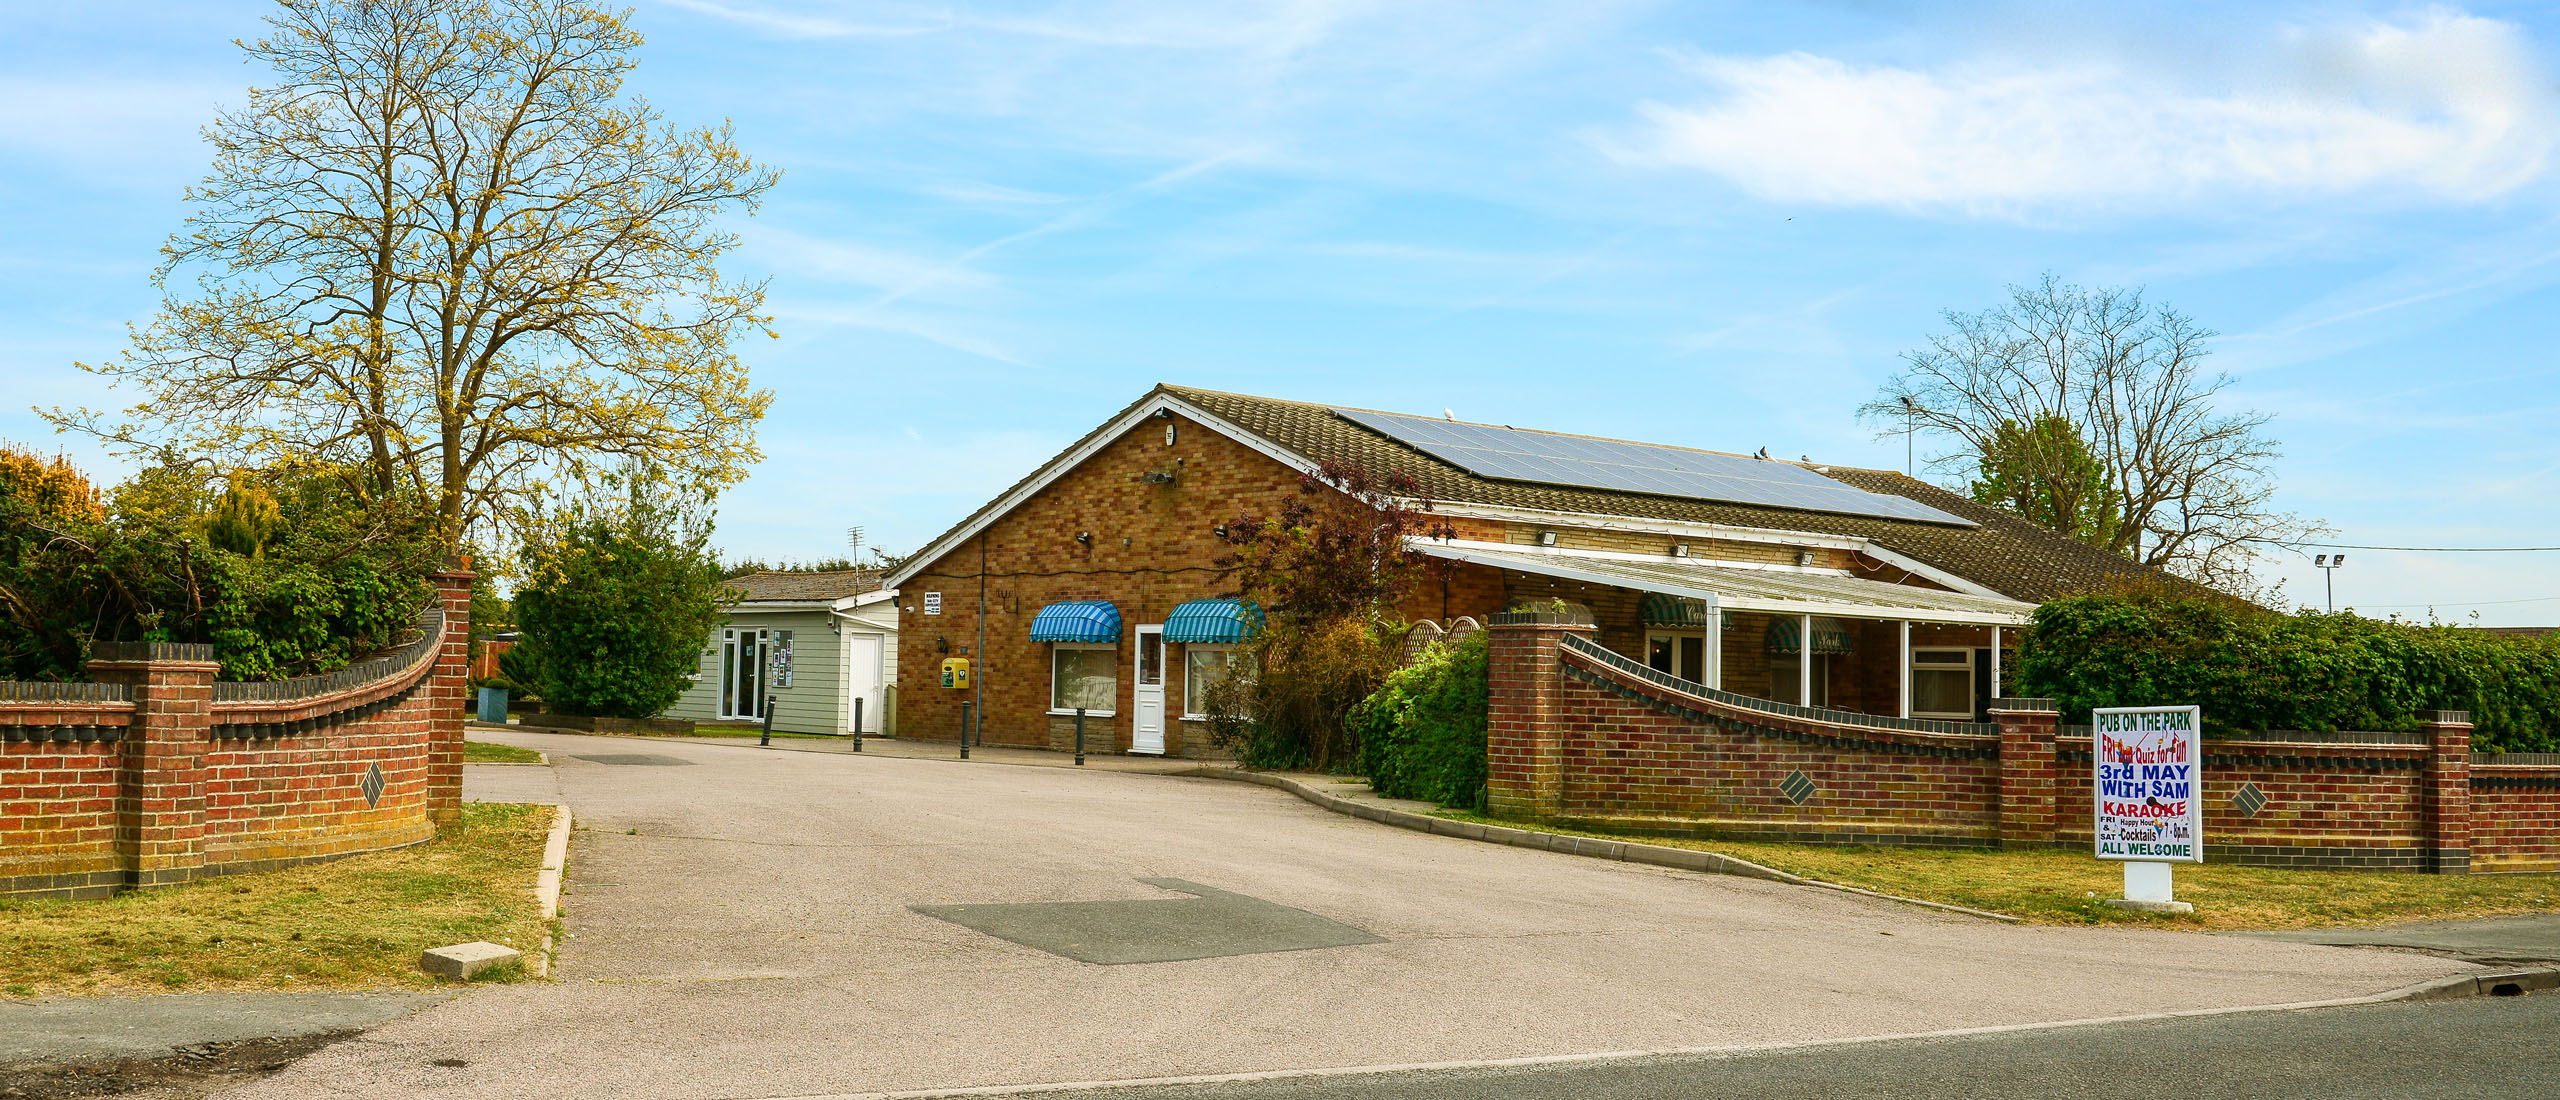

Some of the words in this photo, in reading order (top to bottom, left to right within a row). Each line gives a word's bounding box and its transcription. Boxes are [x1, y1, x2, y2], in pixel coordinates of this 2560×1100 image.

[2100, 713, 2120, 732] PUB
[2123, 713, 2137, 732] ON
[2140, 713, 2160, 731] THE
[2164, 712, 2191, 731] PARK
[2102, 733, 2115, 762] FRI
[2136, 747, 2154, 765] Quiz
[2157, 745, 2169, 763] for
[2171, 738, 2186, 763] Fun
[2100, 764, 2134, 780] 3rd
[2142, 764, 2190, 780] MAY
[2102, 780, 2146, 799] WITH
[2152, 780, 2189, 799] SAM
[2104, 800, 2187, 818] KARAOKE
[2121, 818, 2139, 827] Happy
[2120, 828, 2157, 842] Cocktails
[2102, 842, 2124, 854] ALL
[2128, 843, 2190, 857] WELCOME
